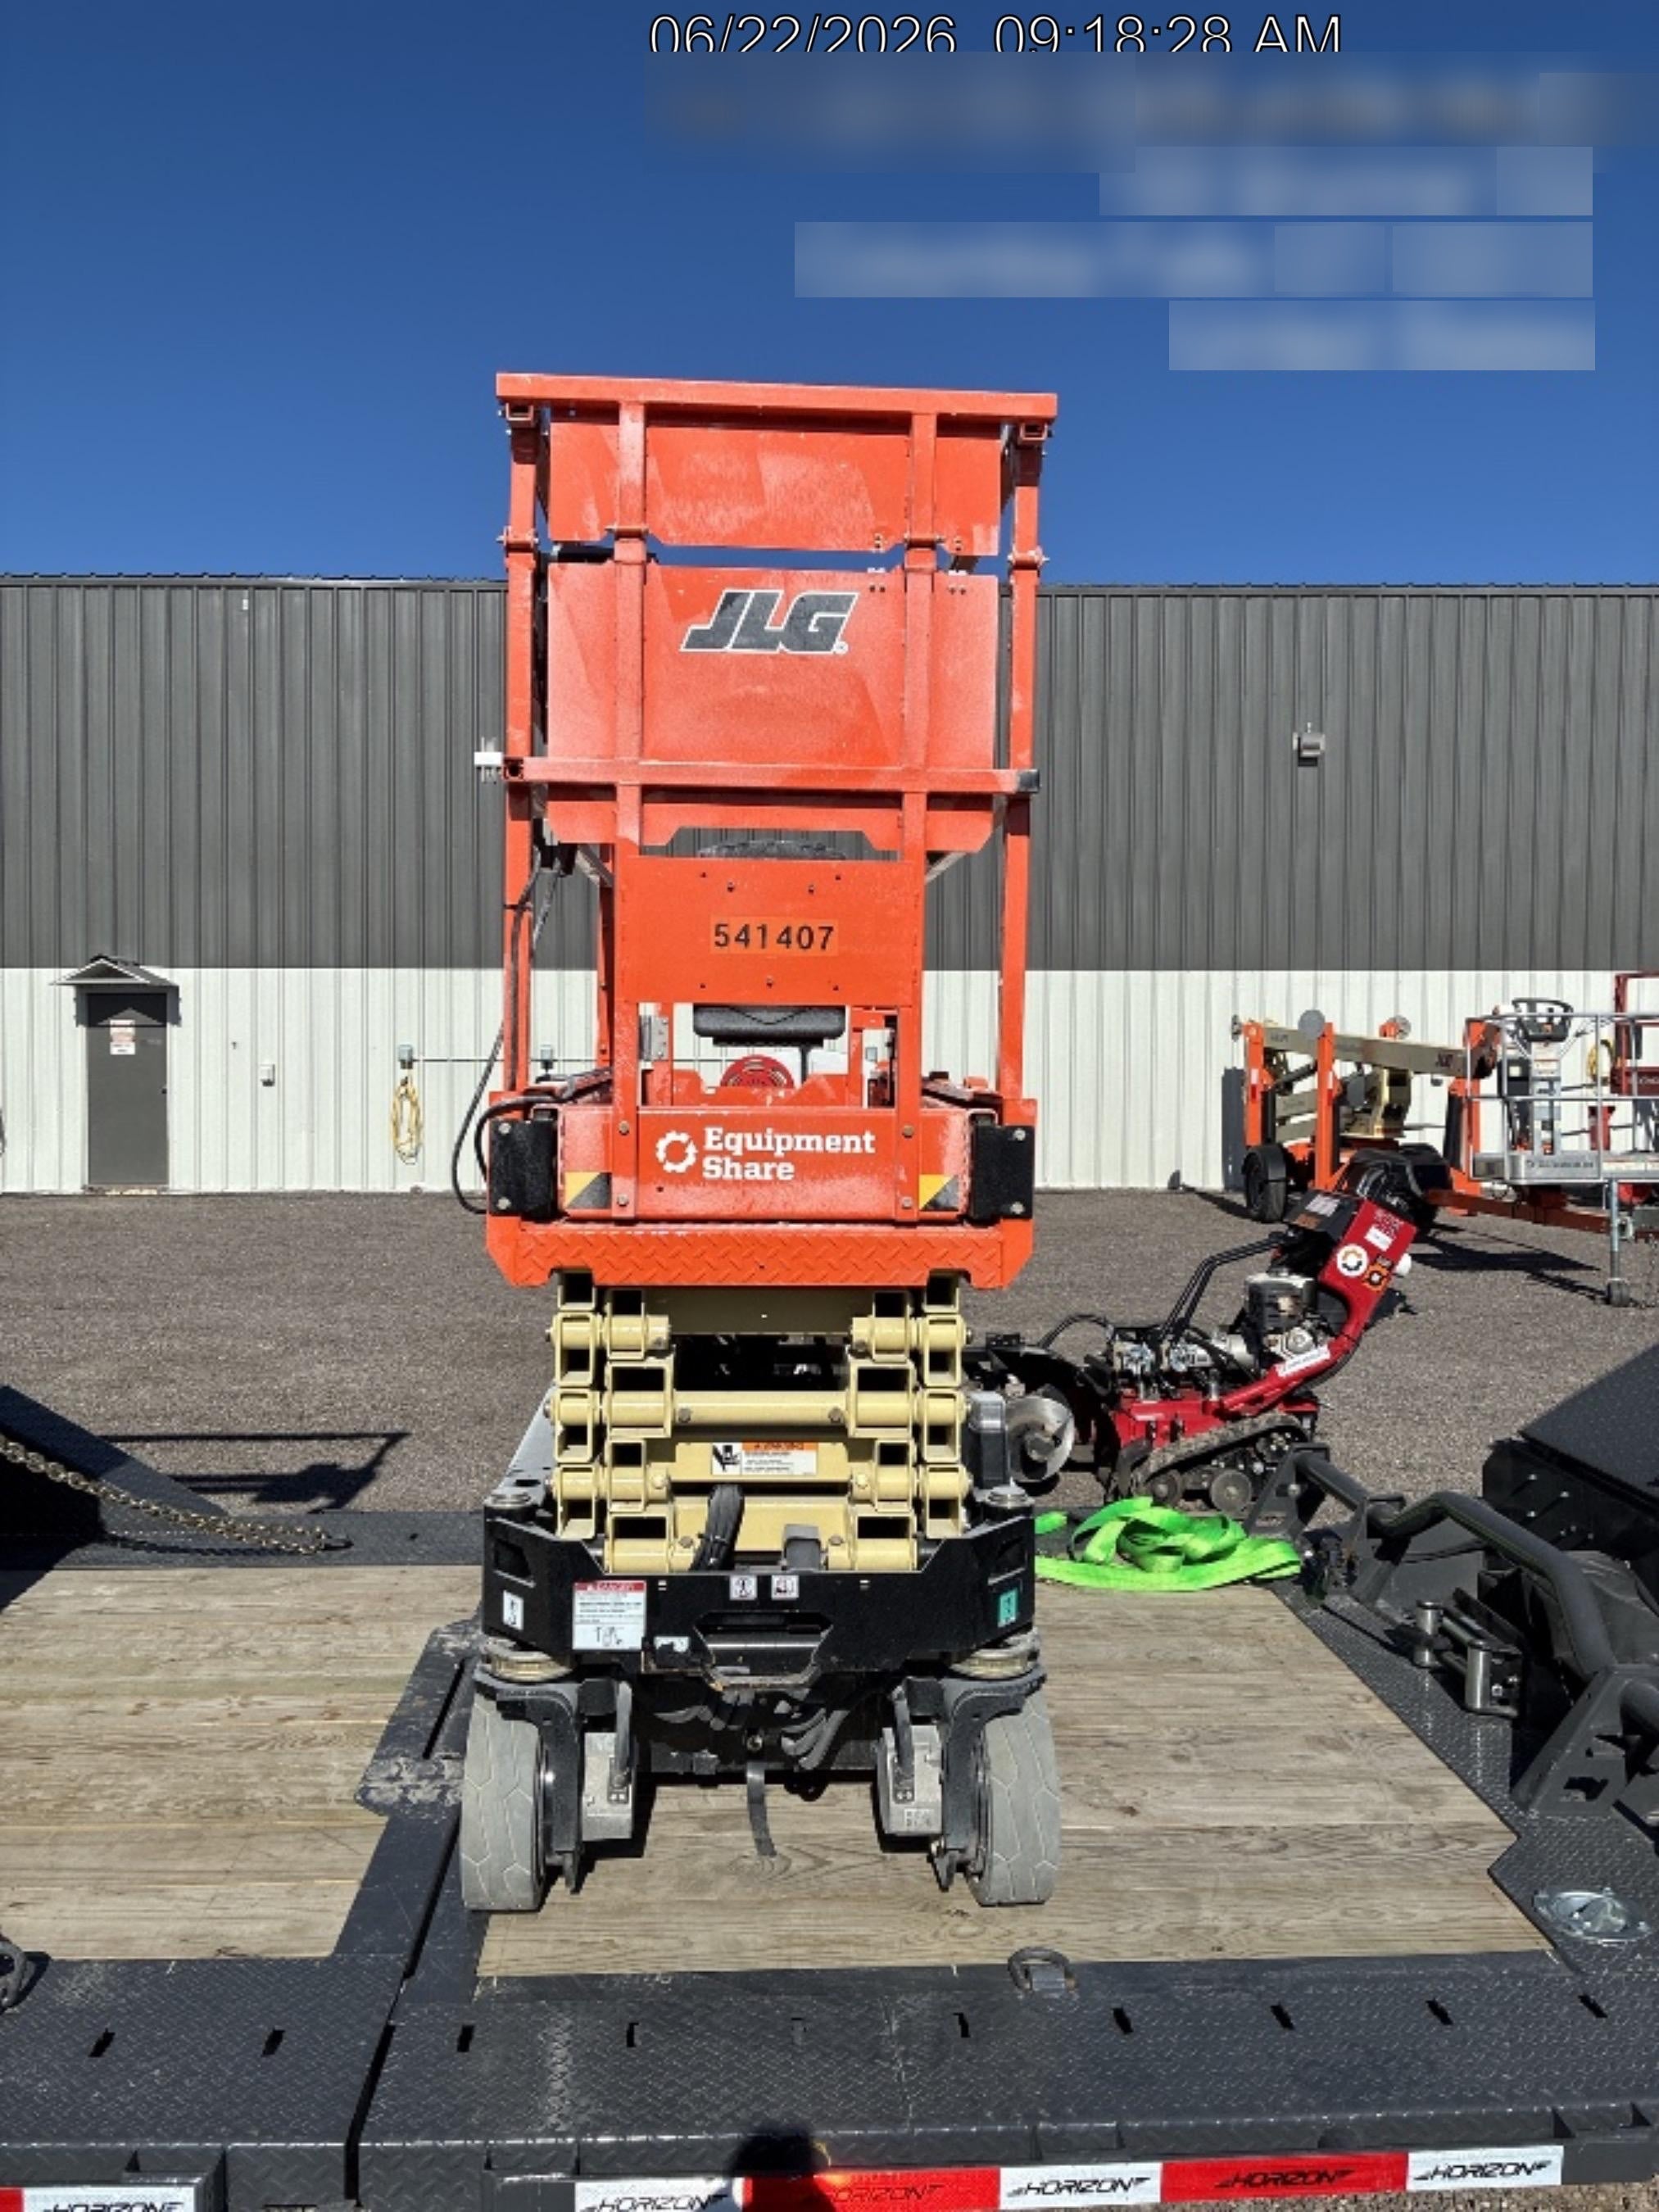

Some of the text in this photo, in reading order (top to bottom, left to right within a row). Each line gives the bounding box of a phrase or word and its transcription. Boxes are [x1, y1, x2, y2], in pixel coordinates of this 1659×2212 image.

[679, 589, 859, 655] JLG
[714, 922, 835, 950] 541407
[703, 1126, 876, 1158] Equipment
[702, 1155, 795, 1181] Share
[1230, 2169, 1337, 2189] HORIZON
[1431, 2161, 1536, 2181] HORIZON
[1025, 2177, 1134, 2196] HORIZON
[598, 2194, 711, 2211] HORIZON
